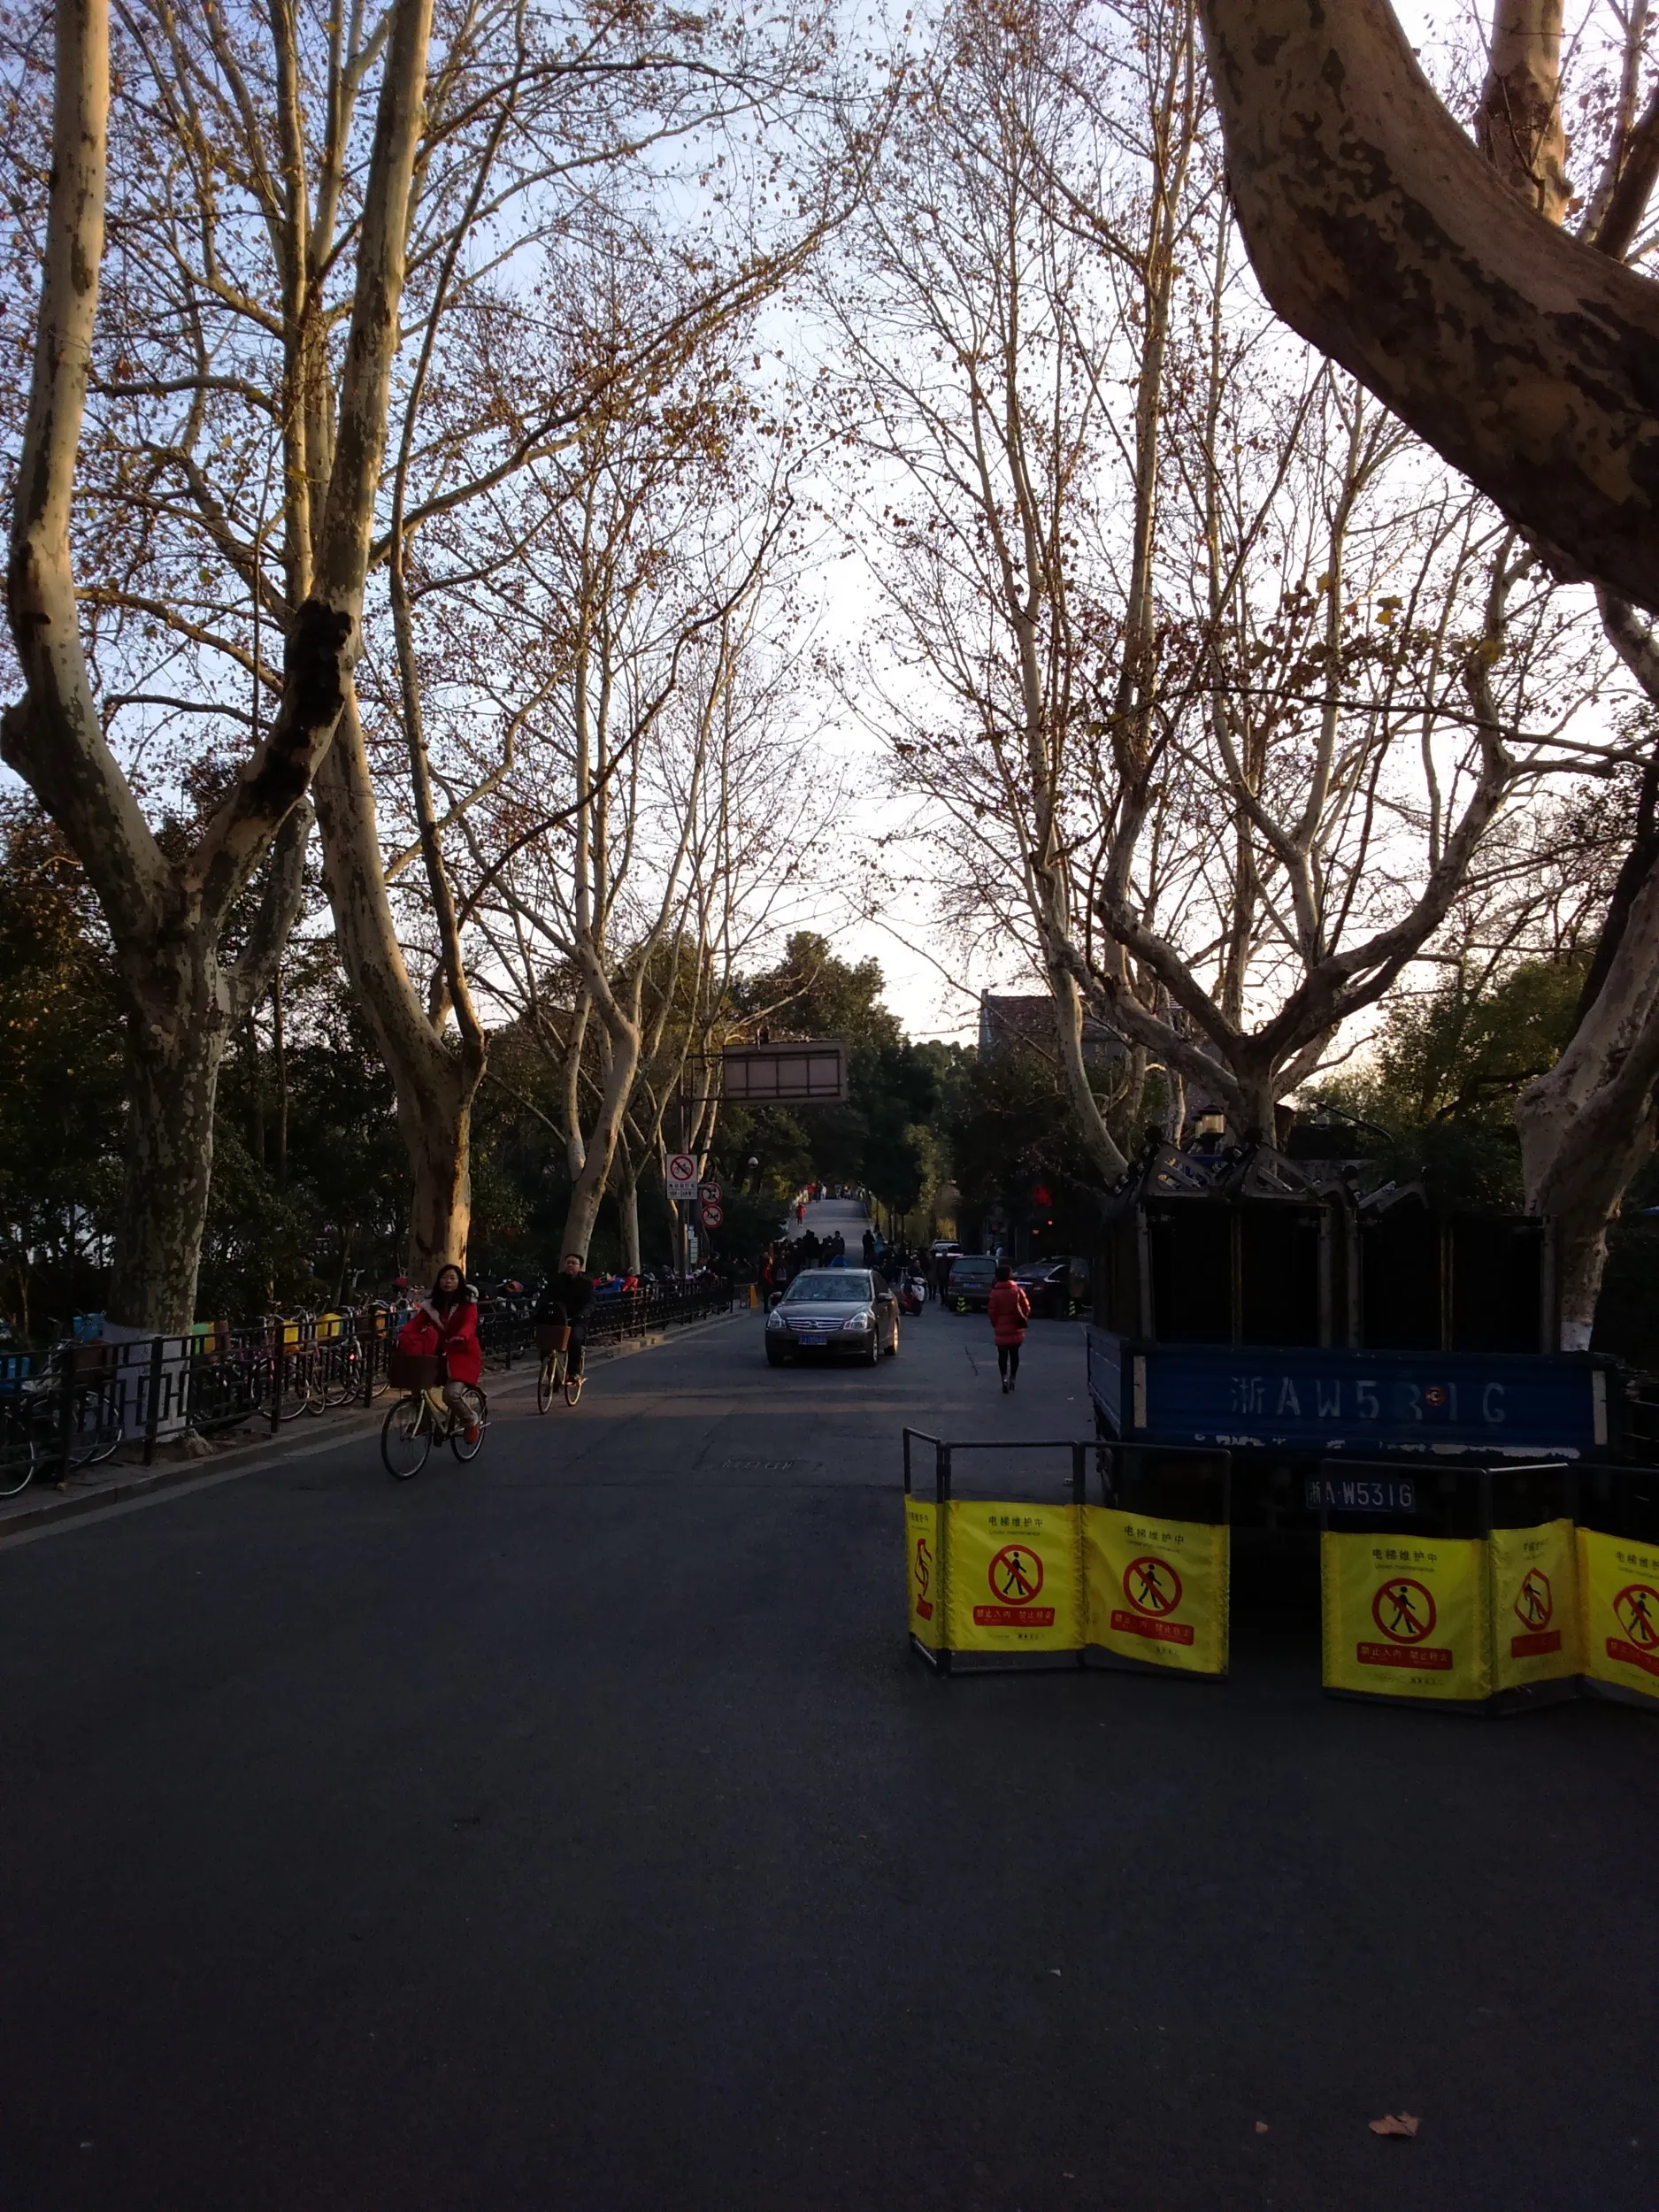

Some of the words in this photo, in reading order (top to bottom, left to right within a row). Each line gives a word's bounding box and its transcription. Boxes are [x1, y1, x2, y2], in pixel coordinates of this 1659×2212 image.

[988, 1516, 1043, 1527] 电梯维护中
[1125, 1525, 1184, 1544] 电梯维护中
[1372, 1548, 1438, 1563] 电梯维护中
